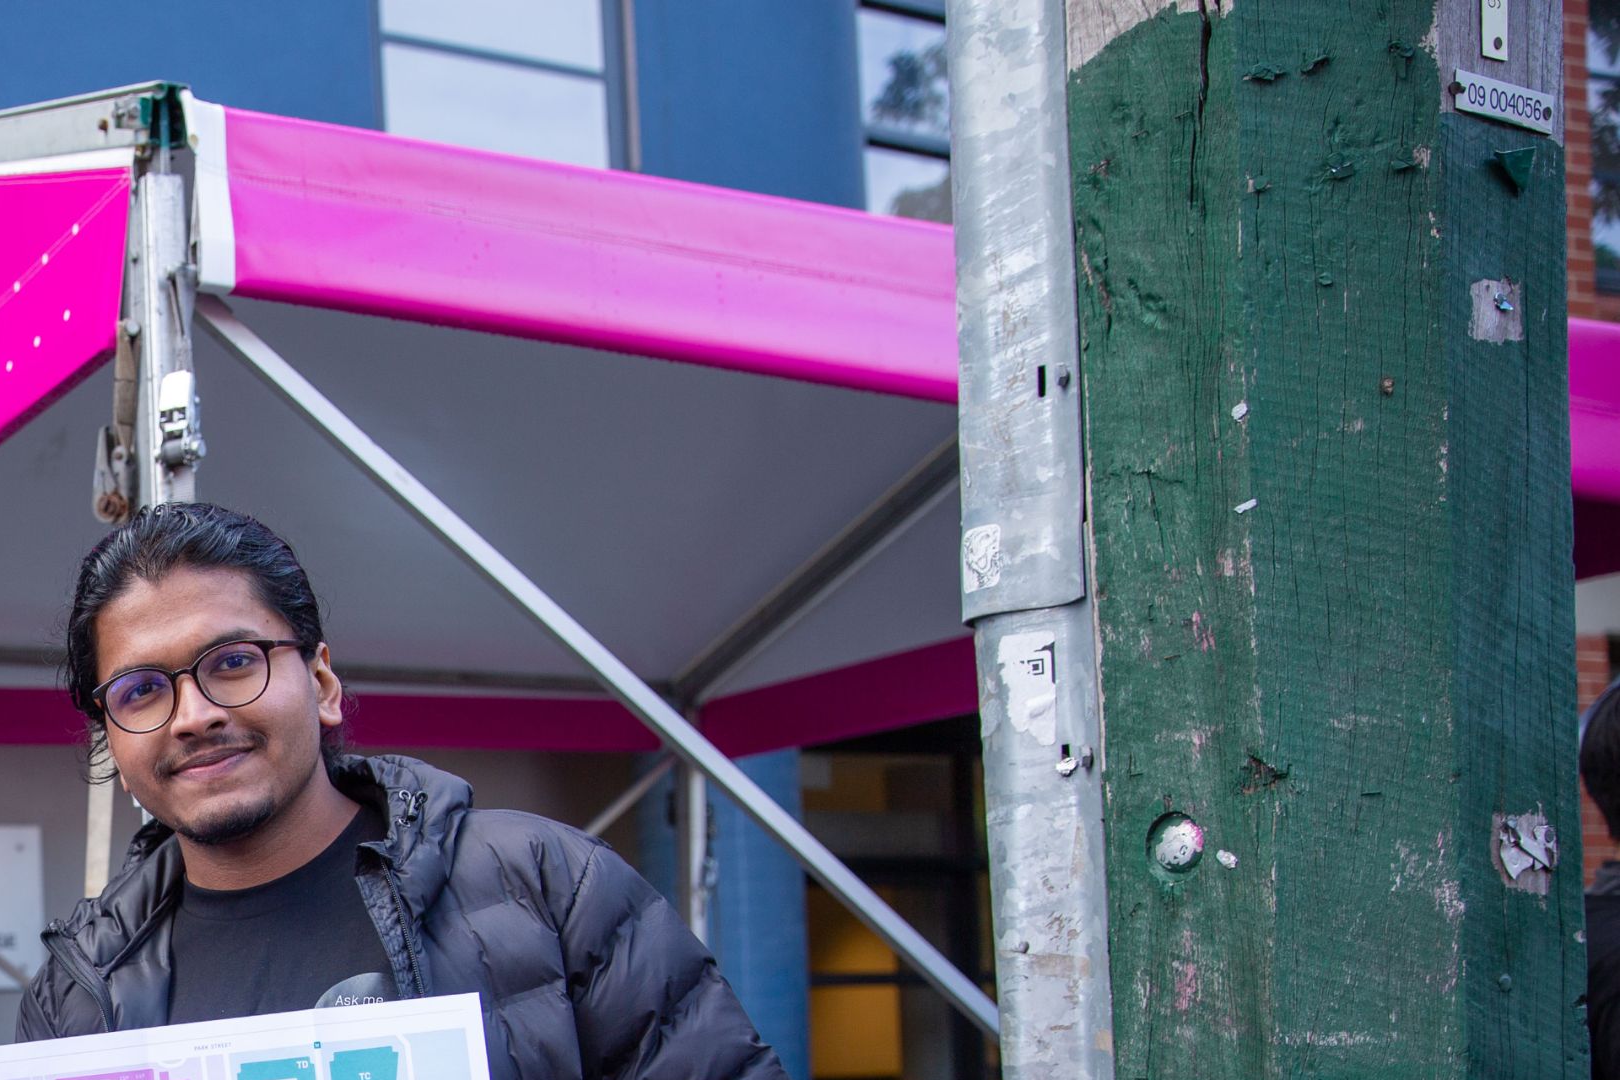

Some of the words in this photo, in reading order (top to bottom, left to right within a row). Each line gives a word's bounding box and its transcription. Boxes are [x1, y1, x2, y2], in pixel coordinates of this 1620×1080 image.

[1467, 82, 1486, 107] 09
[1490, 87, 1542, 121] 004056
[295, 1060, 309, 1069] TD
[358, 1072, 372, 1080] TC
